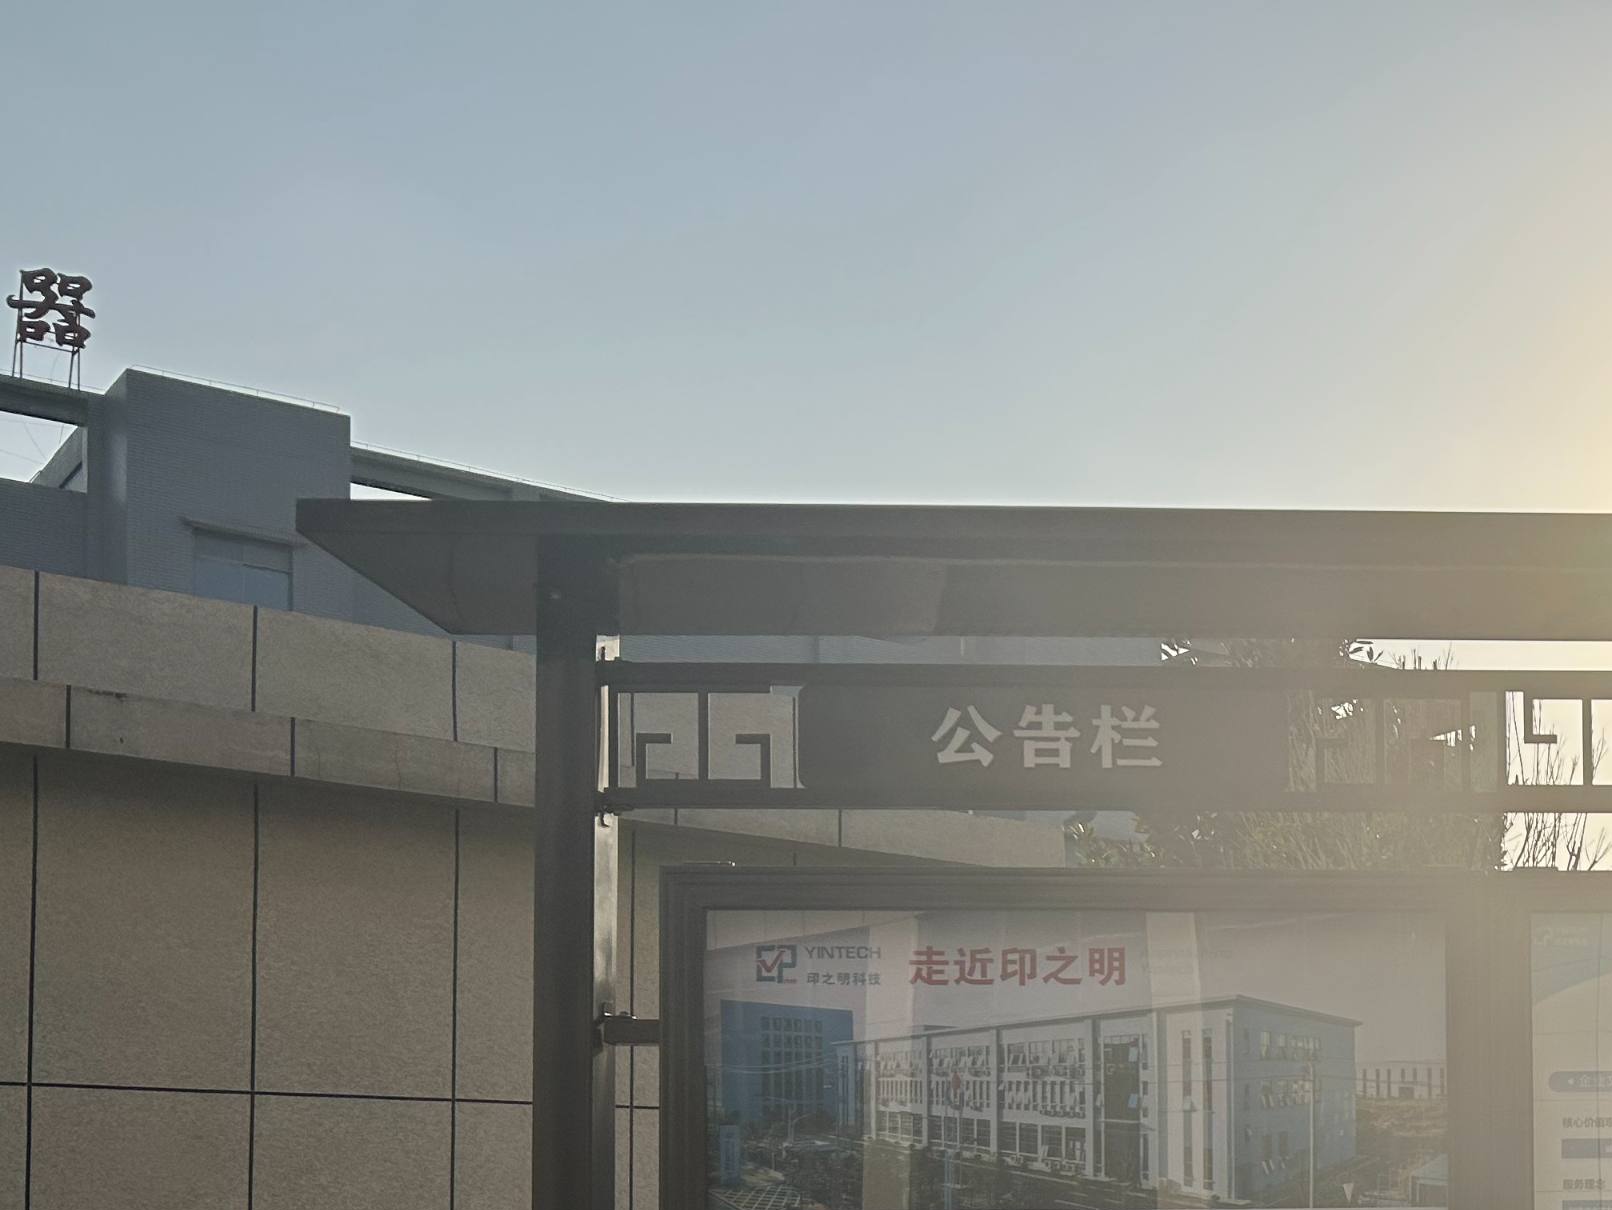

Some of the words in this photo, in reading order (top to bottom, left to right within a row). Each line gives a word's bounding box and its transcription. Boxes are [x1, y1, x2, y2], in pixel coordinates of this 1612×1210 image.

[931, 703, 1163, 769] 公告栏
[804, 945, 881, 960] YINTECH
[910, 945, 1127, 987] 走近印之明
[806, 971, 881, 986] 印之明科技
[1563, 1178, 1606, 1191] 服务理念
